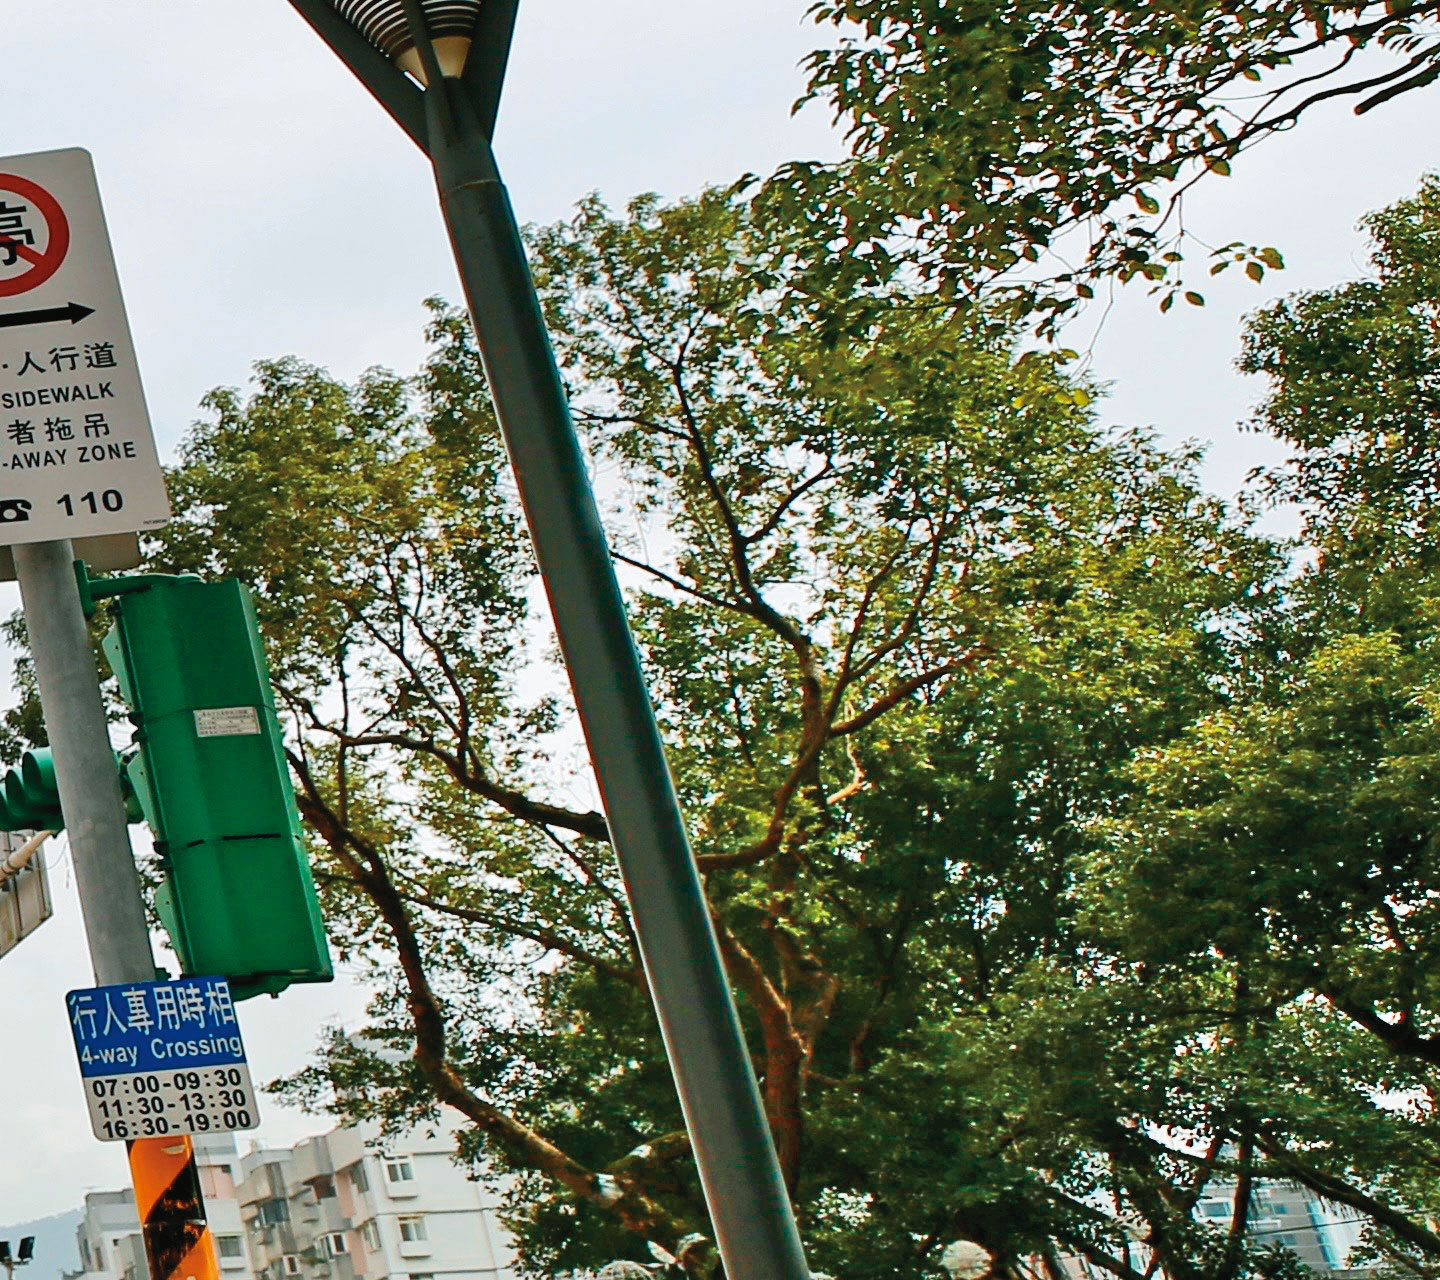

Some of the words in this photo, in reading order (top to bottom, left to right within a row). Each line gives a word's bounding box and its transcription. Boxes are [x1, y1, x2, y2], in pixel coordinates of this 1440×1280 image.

[2, 382, 114, 410] SIDEWALK
[78, 441, 136, 463] ZONE
[57, 489, 123, 517] 110
[70, 981, 236, 1040] 行人專用時相
[81, 1045, 137, 1067] 4-way
[151, 1034, 243, 1059] Crossing
[93, 1068, 241, 1098] 07:00-09:30
[98, 1089, 246, 1118] 11:30-13:30
[103, 1110, 251, 1138] 16:30-19:00
